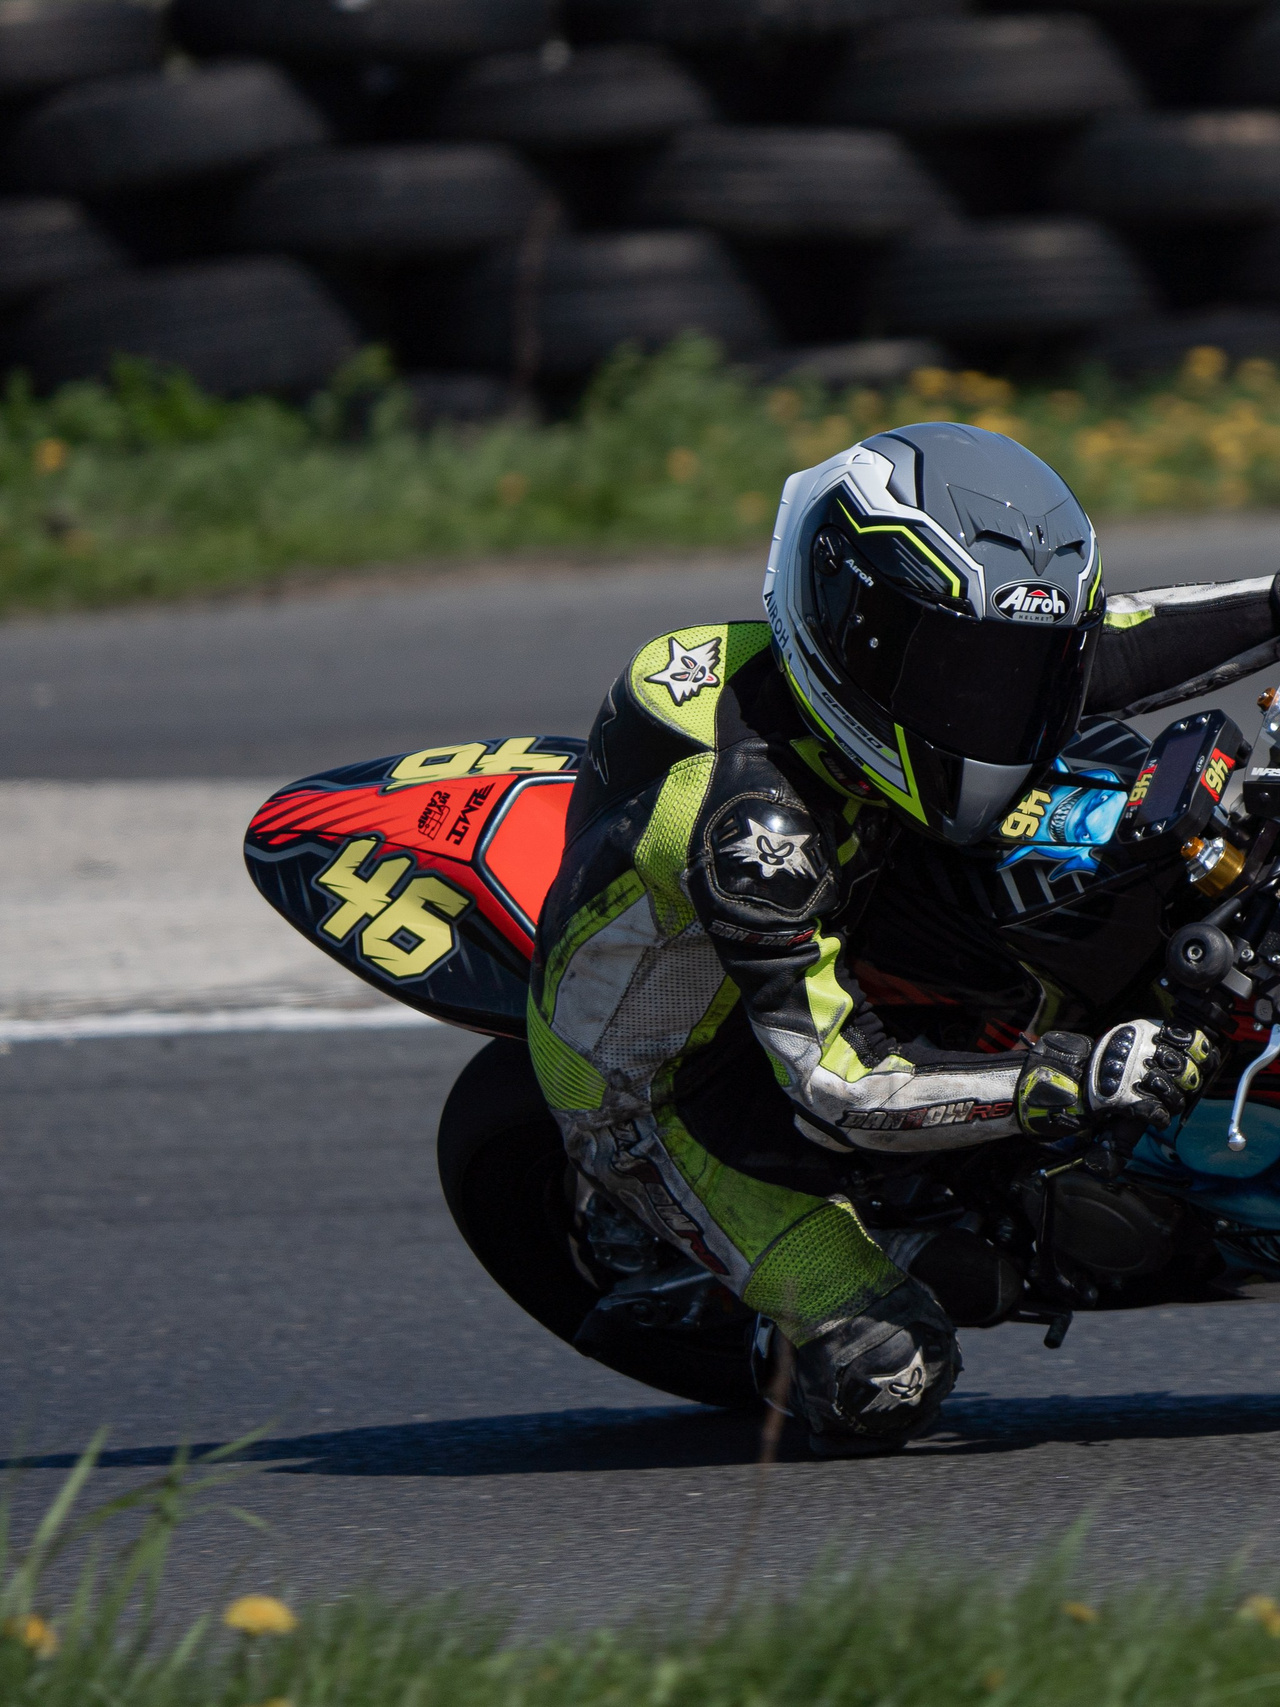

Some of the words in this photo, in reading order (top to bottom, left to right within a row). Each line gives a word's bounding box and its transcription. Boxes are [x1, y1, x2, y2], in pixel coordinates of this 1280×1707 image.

[844, 559, 874, 587] Airoh
[998, 586, 1066, 613] Airoh
[1129, 773, 1153, 802] 46
[1205, 758, 1229, 794] 46
[418, 790, 443, 830] CAMP
[1000, 789, 1052, 838] 46
[317, 836, 471, 978] 46
